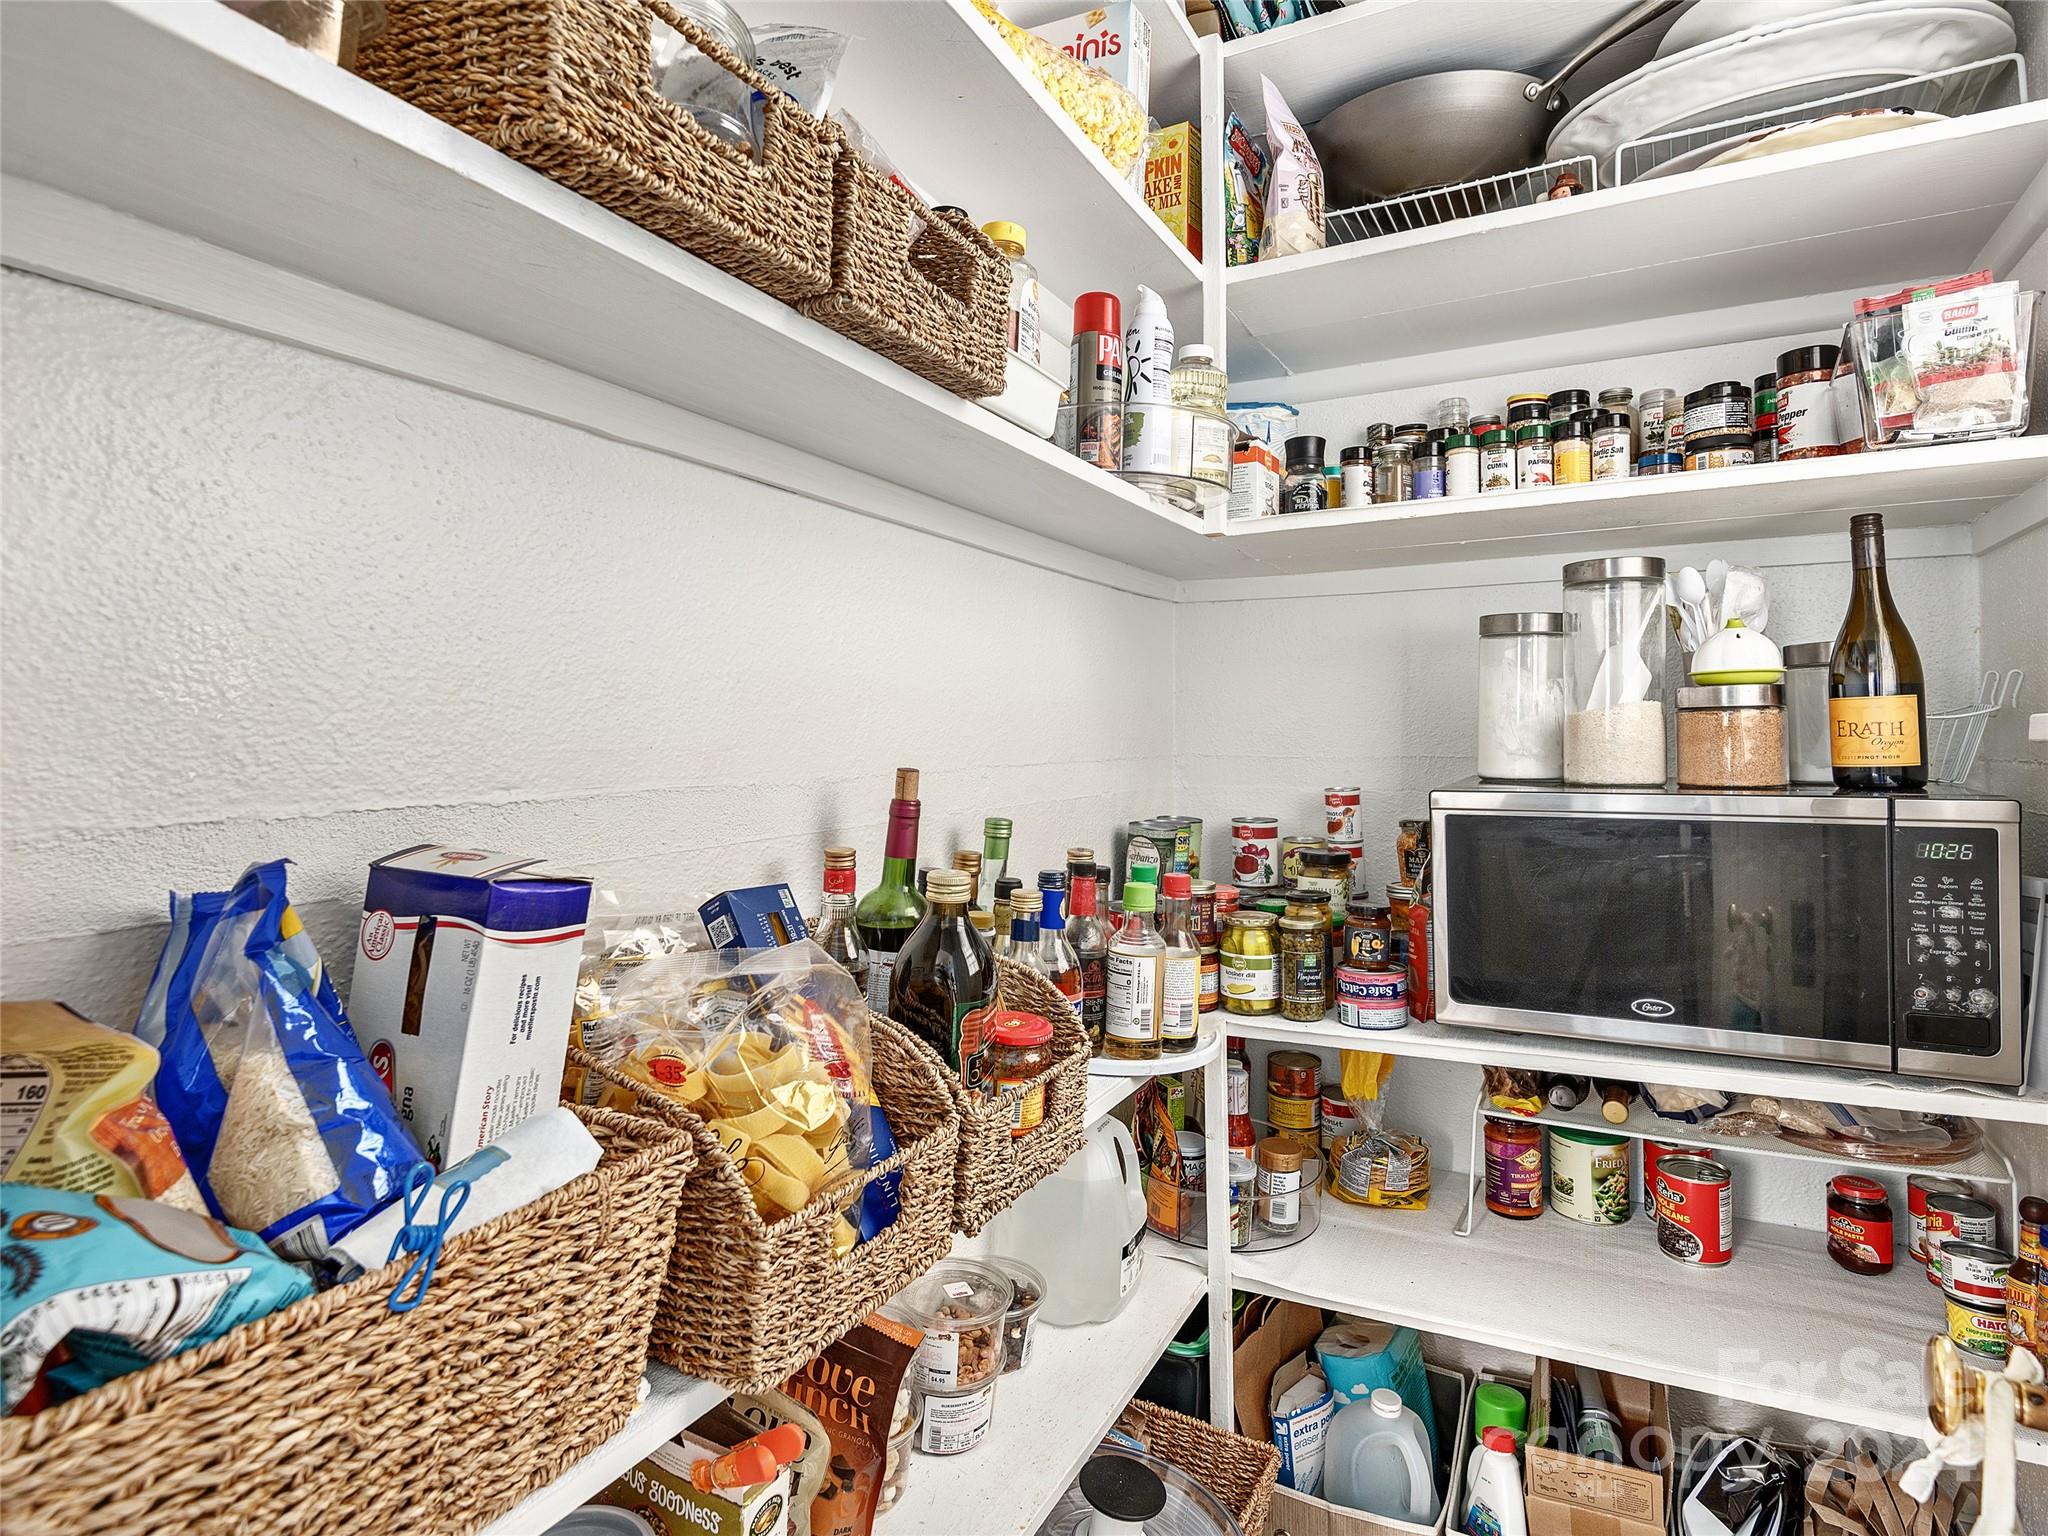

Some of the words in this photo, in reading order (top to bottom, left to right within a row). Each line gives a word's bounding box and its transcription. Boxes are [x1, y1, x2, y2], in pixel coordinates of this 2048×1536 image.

[1174, 174, 1182, 190] AND
[1159, 192, 1182, 210] MIX
[1943, 305, 1977, 320] BADIA
[1644, 420, 1655, 428] Bay
[1609, 446, 1624, 454] Salt
[1487, 462, 1508, 470] CUMIN
[1837, 720, 1904, 738] ERATH
[1871, 736, 1904, 750] Oregon
[1128, 852, 1158, 864] arbanzo
[1924, 843, 1974, 860] 10:26
[367, 932, 373, 945] An
[368, 912, 385, 953] American
[376, 921, 390, 952] Classic
[464, 938, 472, 950] WT
[461, 950, 470, 962] NET
[1225, 970, 1245, 979] kosher
[1246, 970, 1256, 978] dill
[464, 976, 475, 988] OZ
[518, 974, 527, 1000] recipes
[1340, 980, 1367, 996] Catch
[1368, 986, 1393, 996] Safe
[522, 1000, 530, 1018] more
[526, 976, 541, 1041] muellerspasta.com
[1642, 1003, 1663, 1012] Oster
[512, 1001, 523, 1032] delicious
[509, 1033, 517, 1045] For
[17, 1084, 47, 1100] 160
[482, 1085, 496, 1110] Story
[1595, 1156, 1624, 1169] FRIED
[1661, 1207, 1691, 1224] BEANS
[1844, 1232, 1865, 1241] PASTE
[1973, 1273, 2007, 1286] chiles
[1966, 1327, 1991, 1338] CHOPPED
[1293, 1422, 1318, 1438] extra
[838, 1429, 871, 1448] GRANOLA
[1294, 1432, 1320, 1451] eraser
[833, 1526, 853, 1536] DARK
